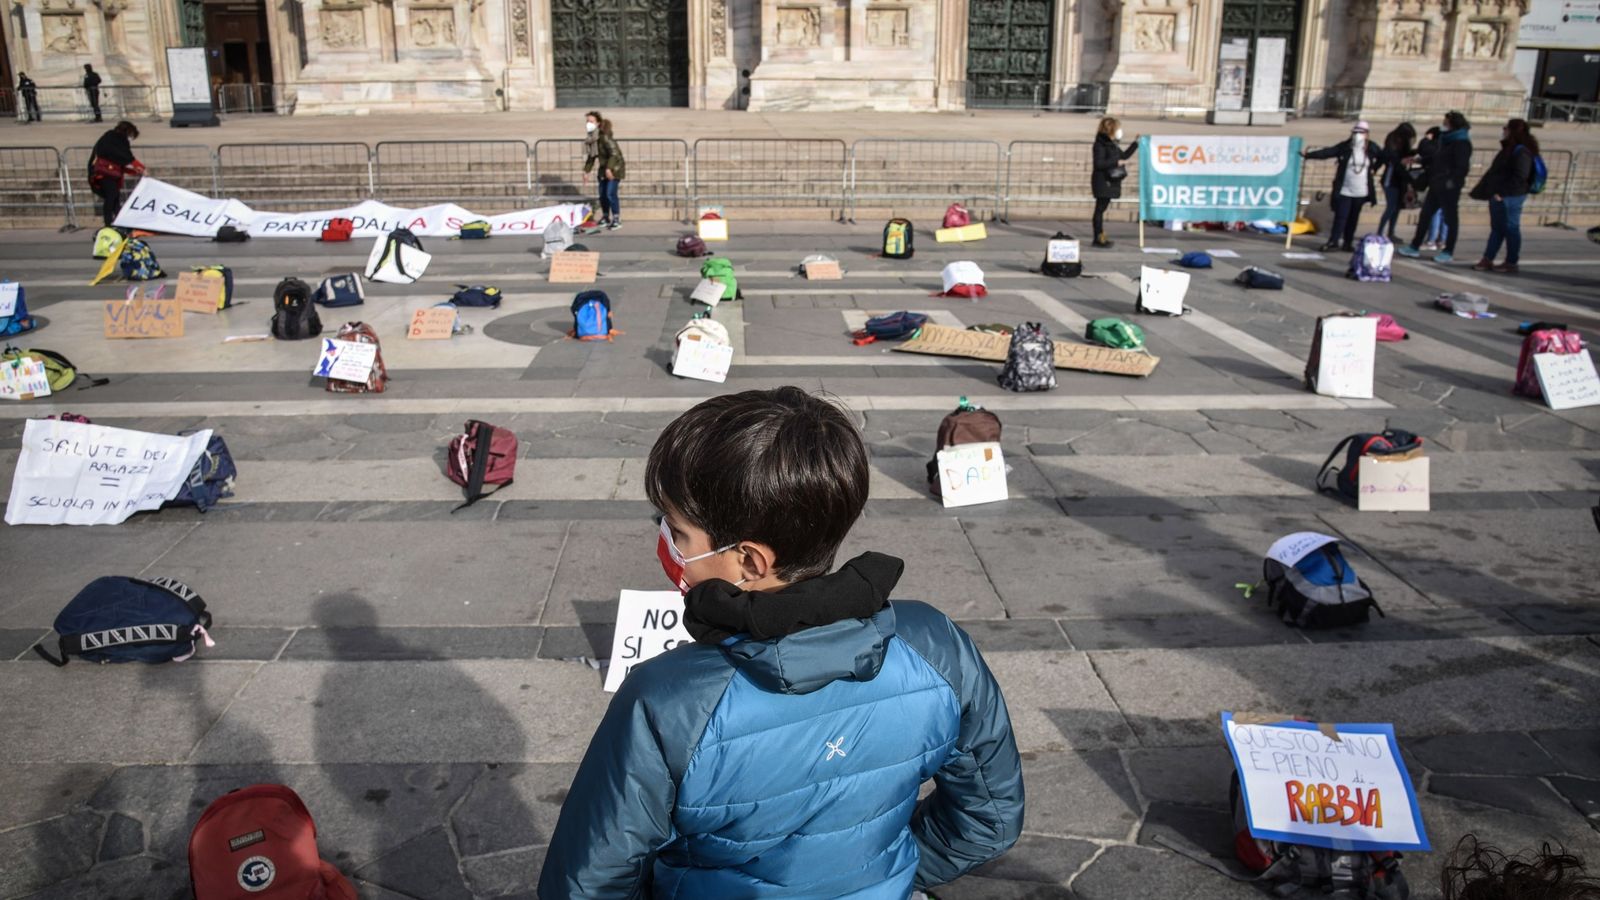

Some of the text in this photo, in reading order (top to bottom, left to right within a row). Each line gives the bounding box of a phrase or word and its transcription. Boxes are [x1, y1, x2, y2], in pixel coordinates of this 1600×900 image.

[1157, 145, 1207, 164] ECA
[1152, 184, 1284, 206] DIRETTIVO
[129, 196, 156, 212] LA
[162, 203, 242, 226] SALUT
[42, 438, 168, 460] SALUTE DEI
[89, 463, 154, 475] RAGAZZI
[25, 496, 95, 510] SCUOLA
[103, 501, 120, 510] IN
[621, 635, 643, 659] SI
[1233, 725, 1320, 753] QUESTO
[1272, 752, 1339, 781] PIENO
[1285, 779, 1383, 828] RABBIA
